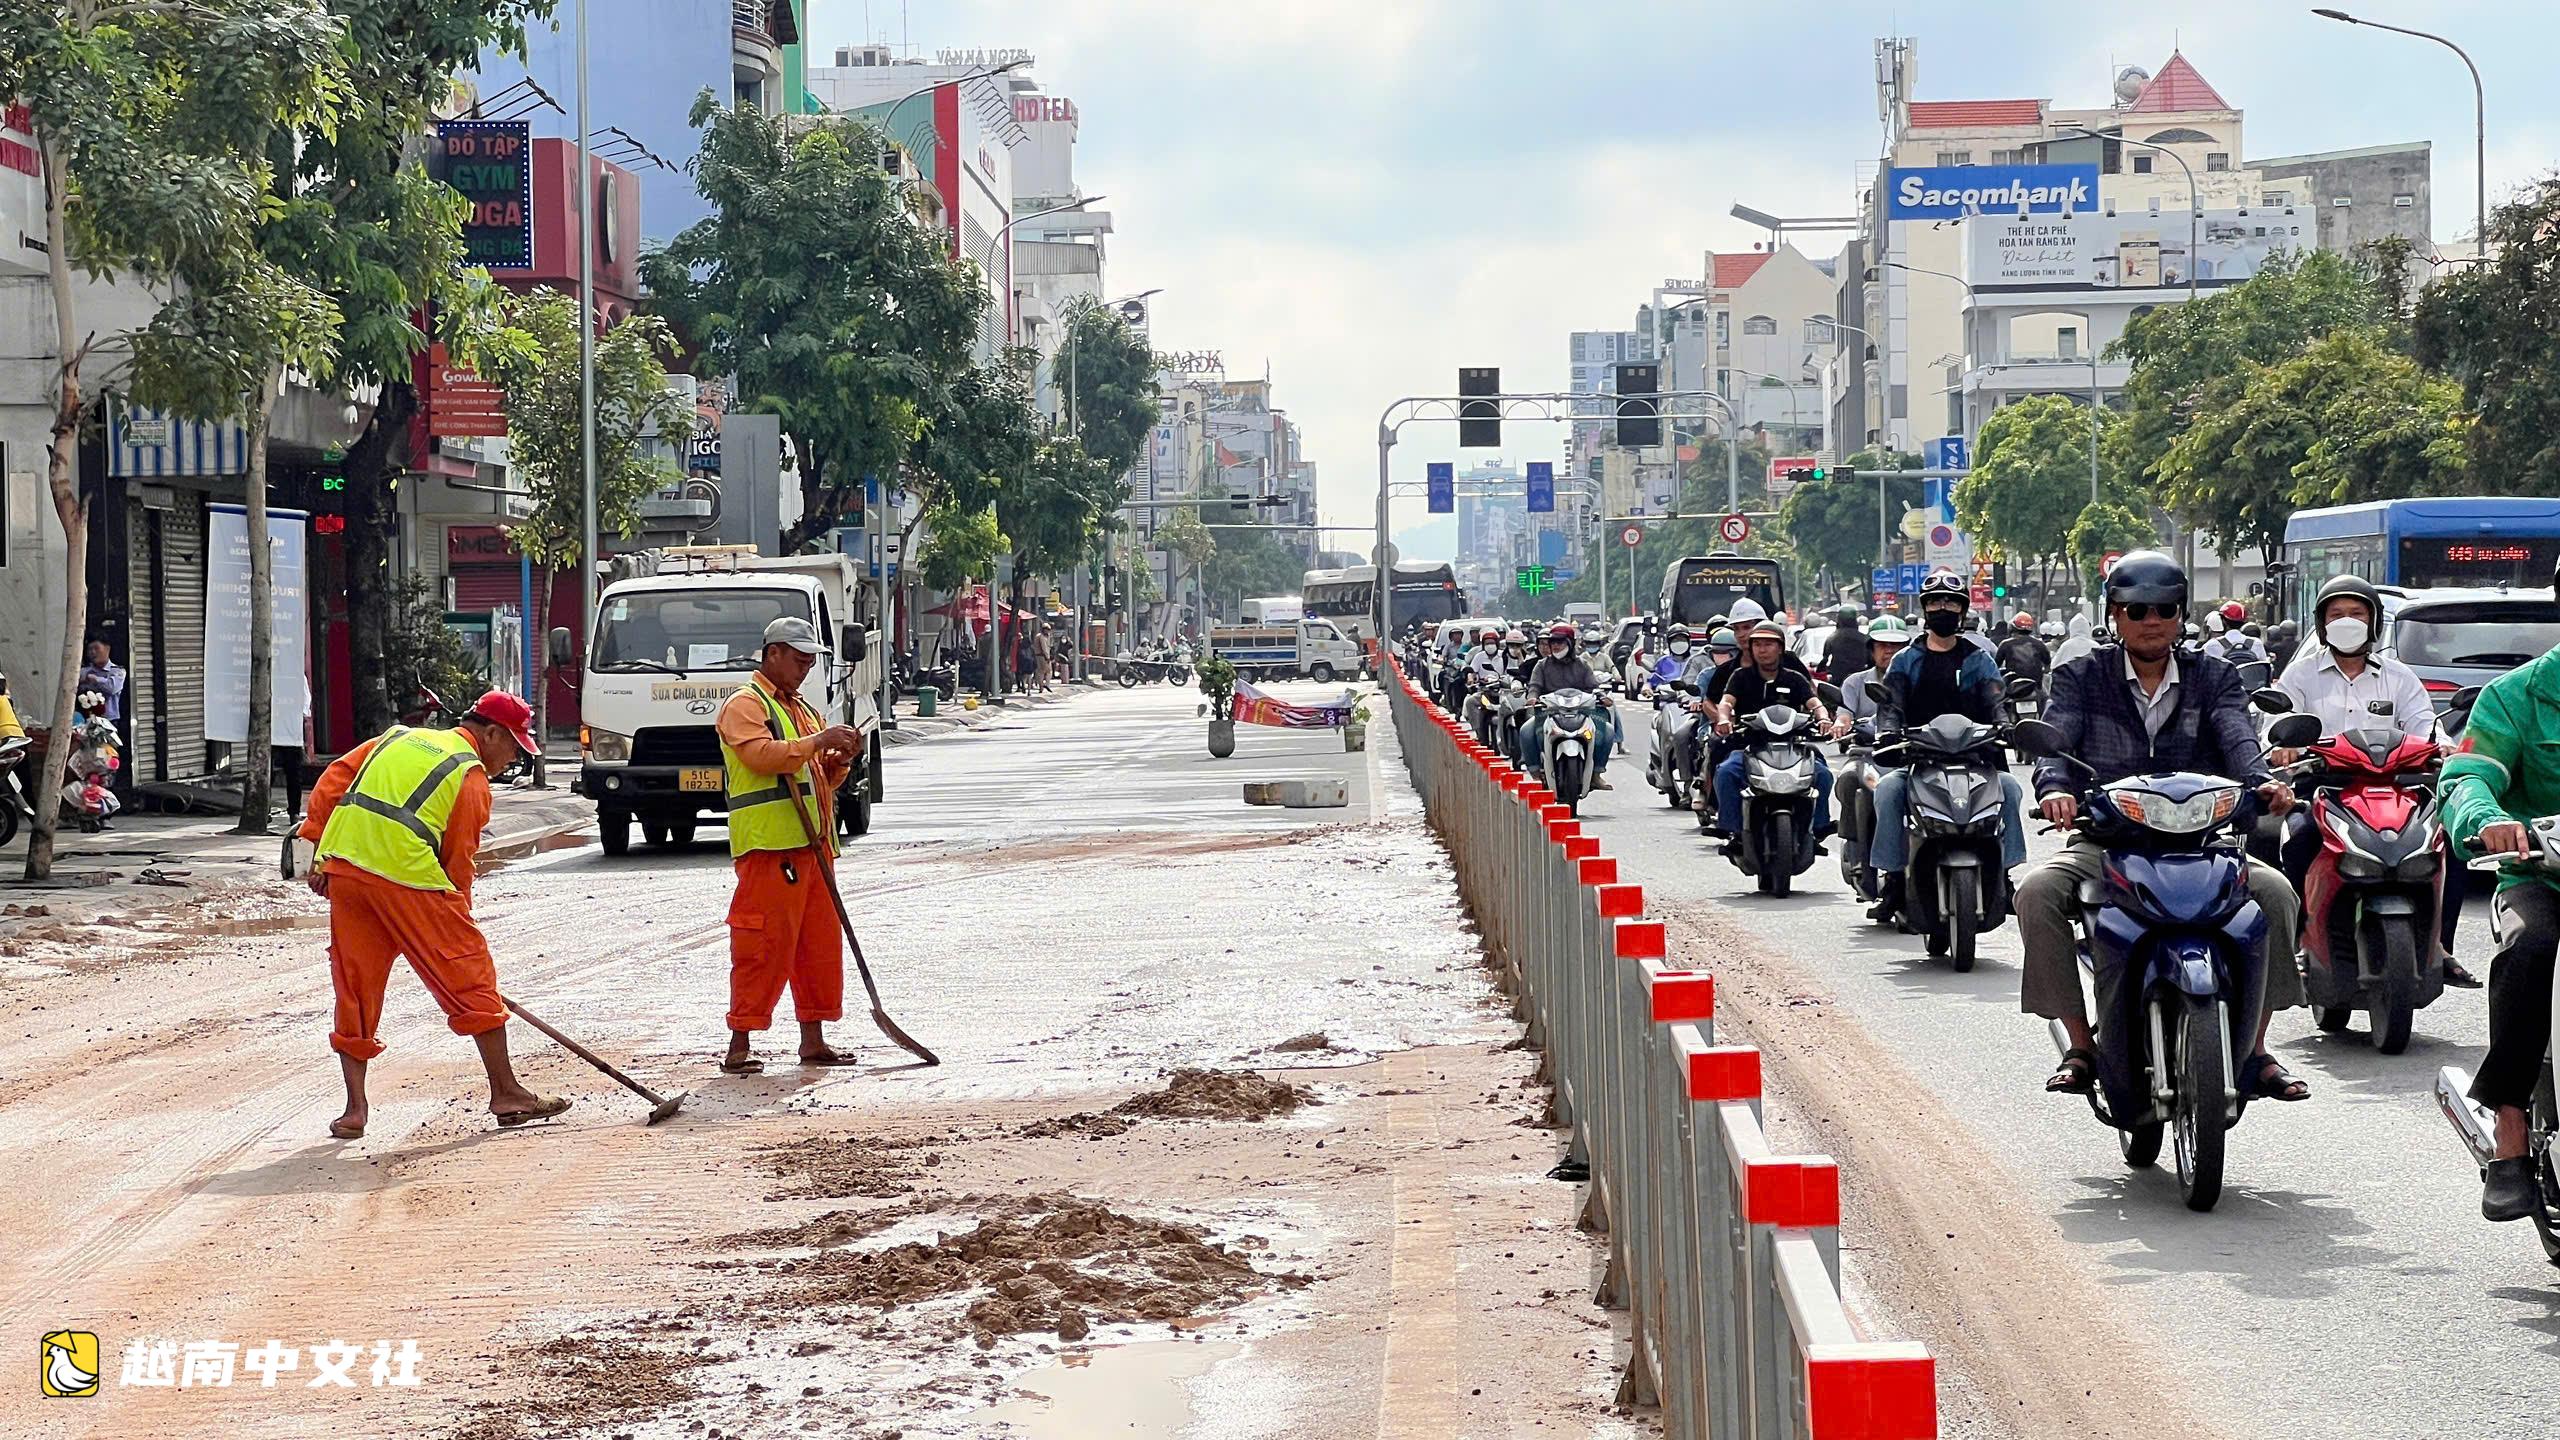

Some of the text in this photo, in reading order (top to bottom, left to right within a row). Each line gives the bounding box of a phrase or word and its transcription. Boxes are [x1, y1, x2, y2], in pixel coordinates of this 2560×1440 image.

[1013, 98, 1073, 122] HOTEL
[453, 164, 516, 191] GYM
[1899, 176, 2089, 207] Sacombank
[1686, 577, 1771, 585] LIMOUSINE
[691, 770, 710, 781] 51C
